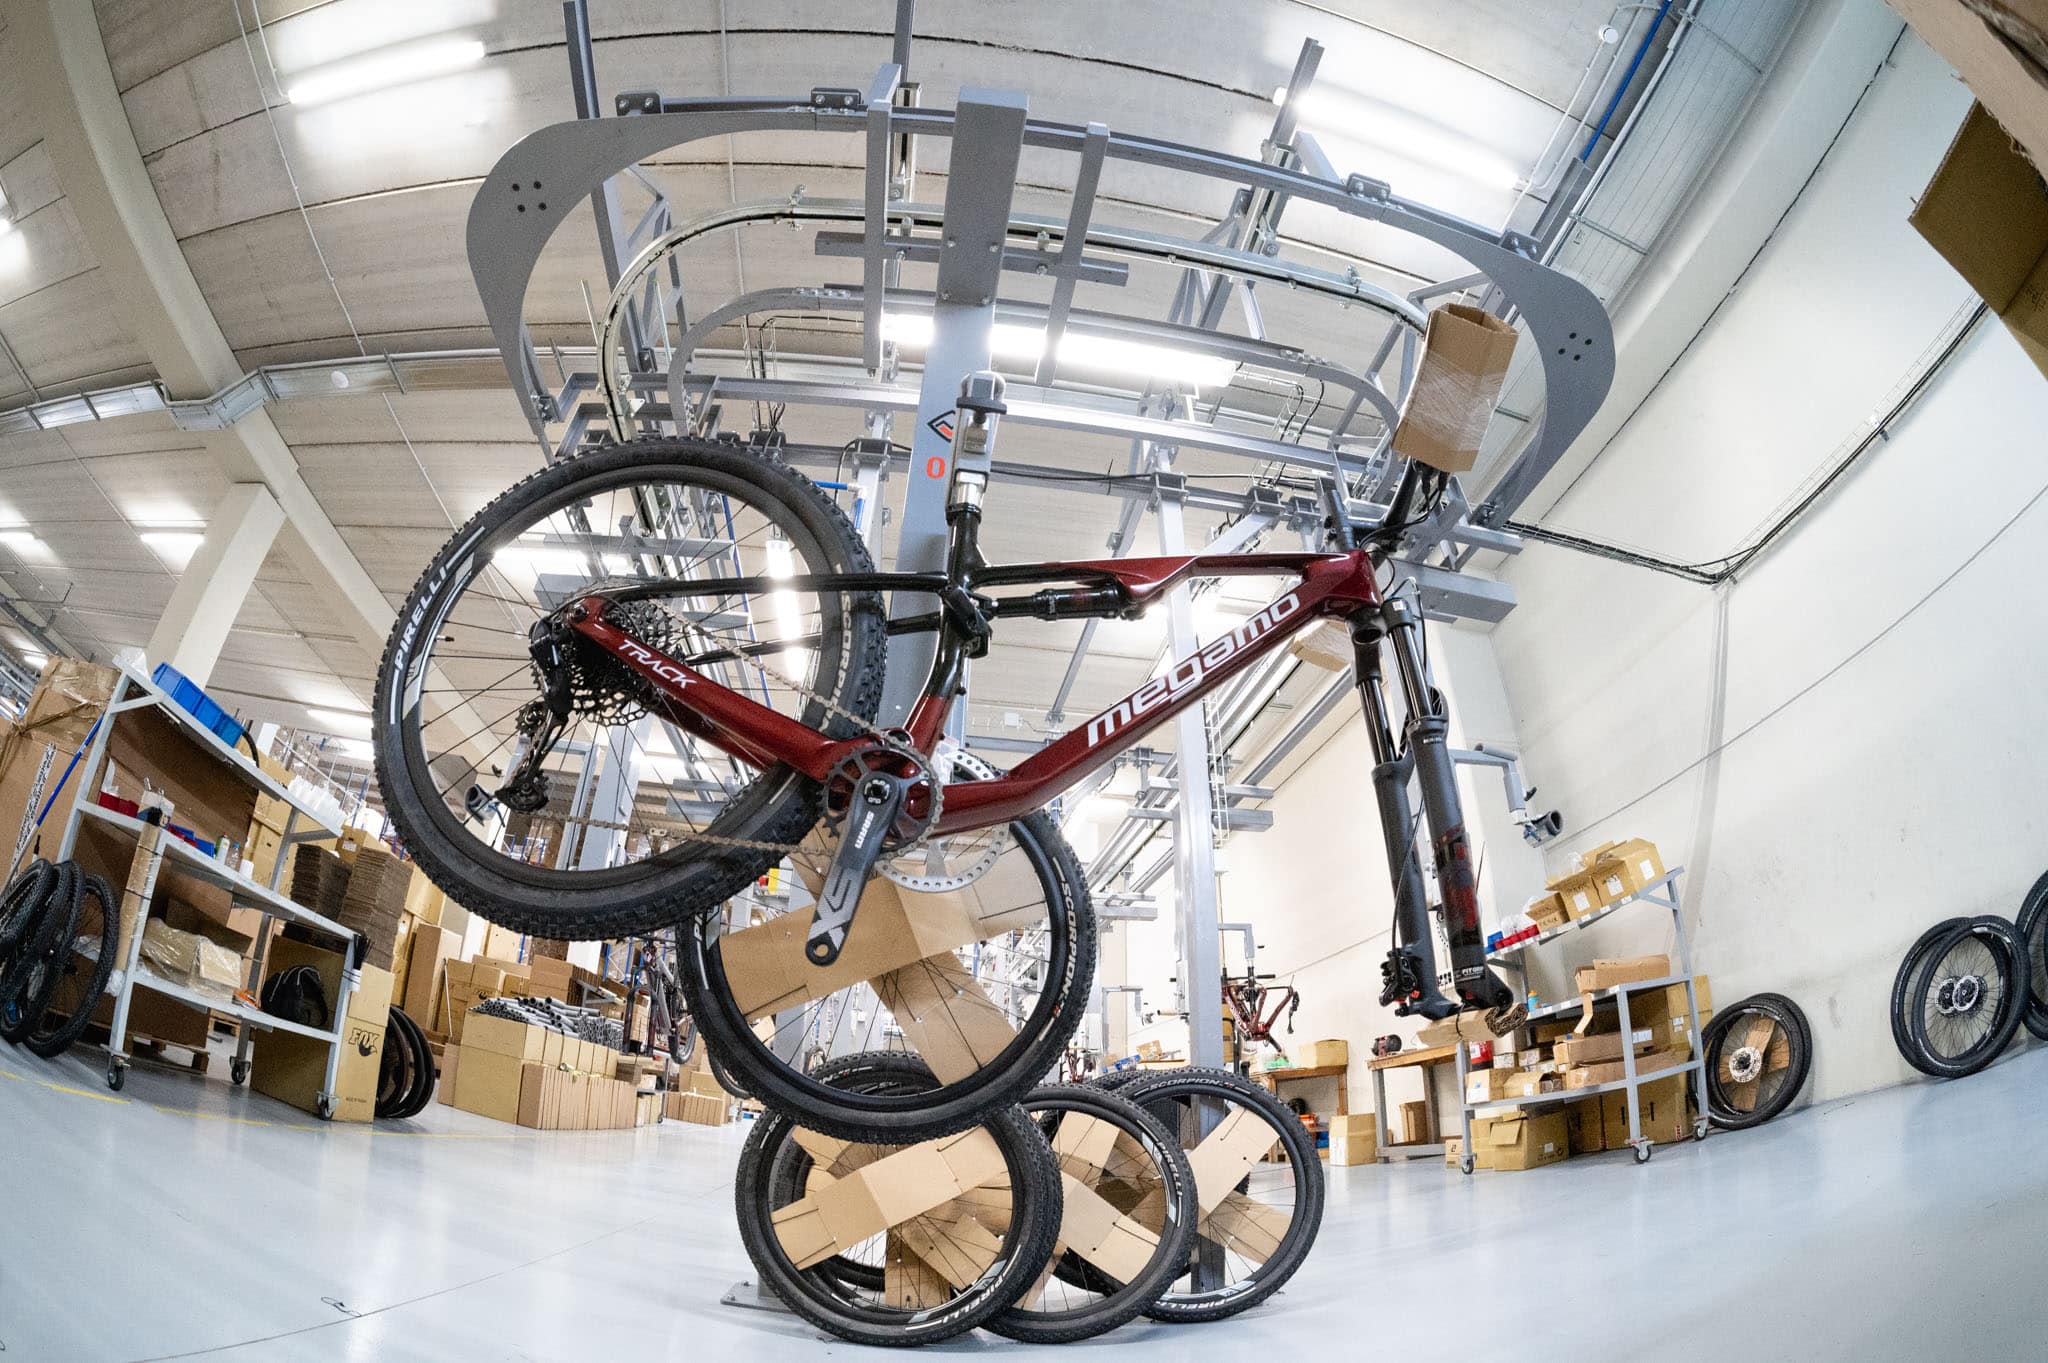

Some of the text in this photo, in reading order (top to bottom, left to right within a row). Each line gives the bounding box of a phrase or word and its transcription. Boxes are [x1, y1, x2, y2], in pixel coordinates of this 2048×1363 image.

[394, 566, 447, 671] PIRELLI
[618, 638, 697, 689] TRACK
[1088, 593, 1300, 748] megamo
[854, 810, 875, 849] SRAM
[1061, 882, 1077, 1000] SCORPION
[348, 1027, 380, 1049] FOX
[1150, 1078, 1220, 1090] SCORPION
[1158, 1141, 1183, 1196] PIRELLI
[943, 1275, 1003, 1324] PIRELLI
